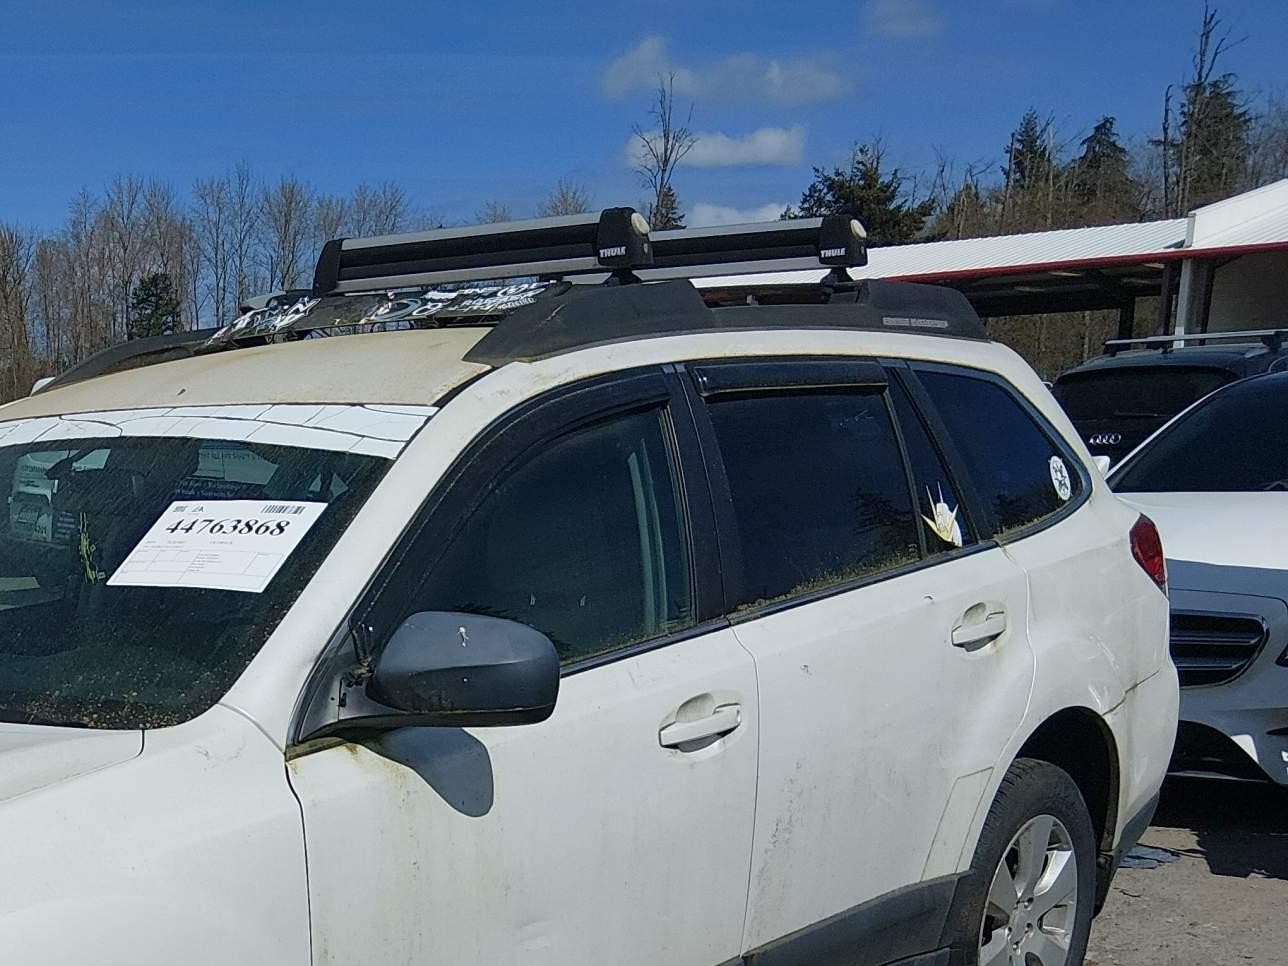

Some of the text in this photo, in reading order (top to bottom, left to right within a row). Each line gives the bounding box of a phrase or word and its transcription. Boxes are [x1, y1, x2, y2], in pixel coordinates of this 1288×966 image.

[599, 246, 626, 257] THULE
[820, 247, 846, 258] THULE
[165, 517, 291, 537] 44763868
